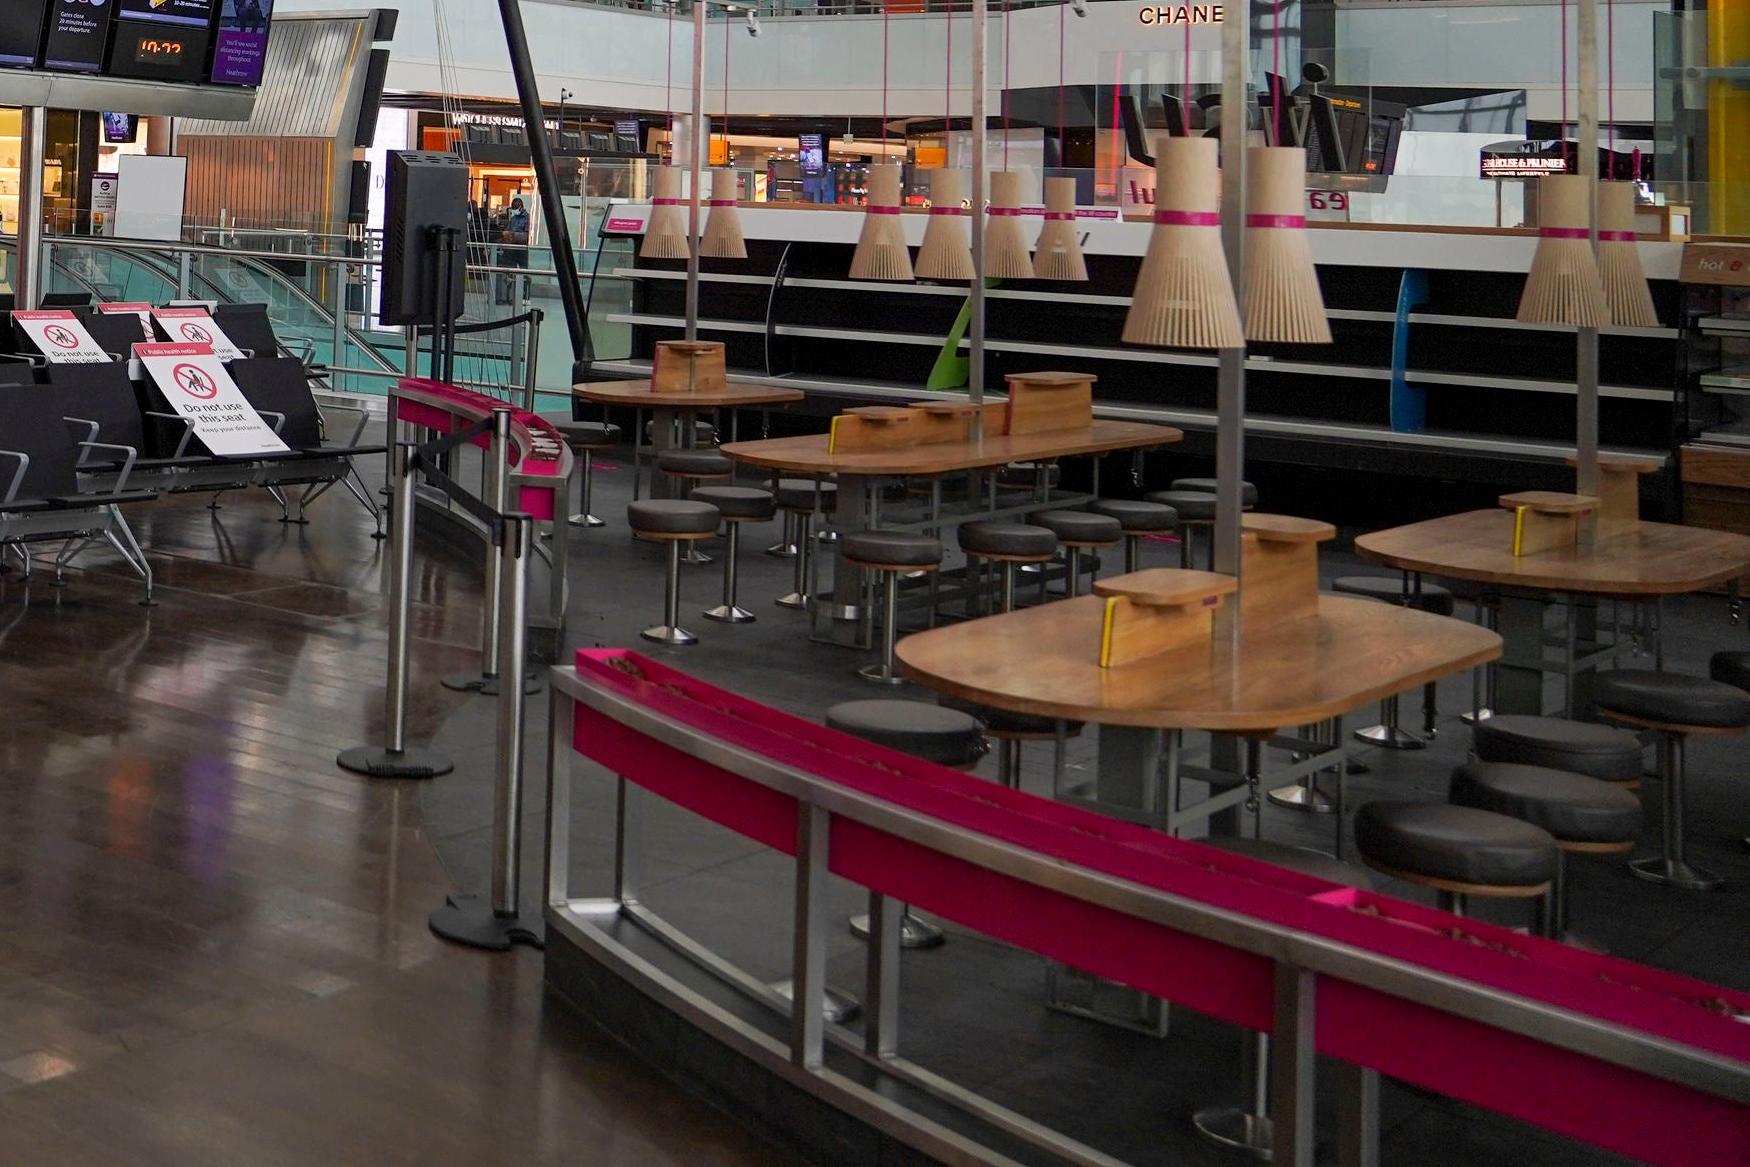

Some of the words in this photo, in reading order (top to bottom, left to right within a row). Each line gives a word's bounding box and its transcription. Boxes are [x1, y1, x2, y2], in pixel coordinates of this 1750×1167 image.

[61, 11, 73, 19] Gates
[1139, 5, 1224, 25] CHANE
[1495, 158, 1518, 167] HOUSE
[1698, 258, 1724, 271] hot
[67, 349, 81, 357] not
[183, 403, 201, 412] Do
[202, 403, 222, 412] not
[198, 414, 221, 423] this
[222, 413, 247, 421] seat
